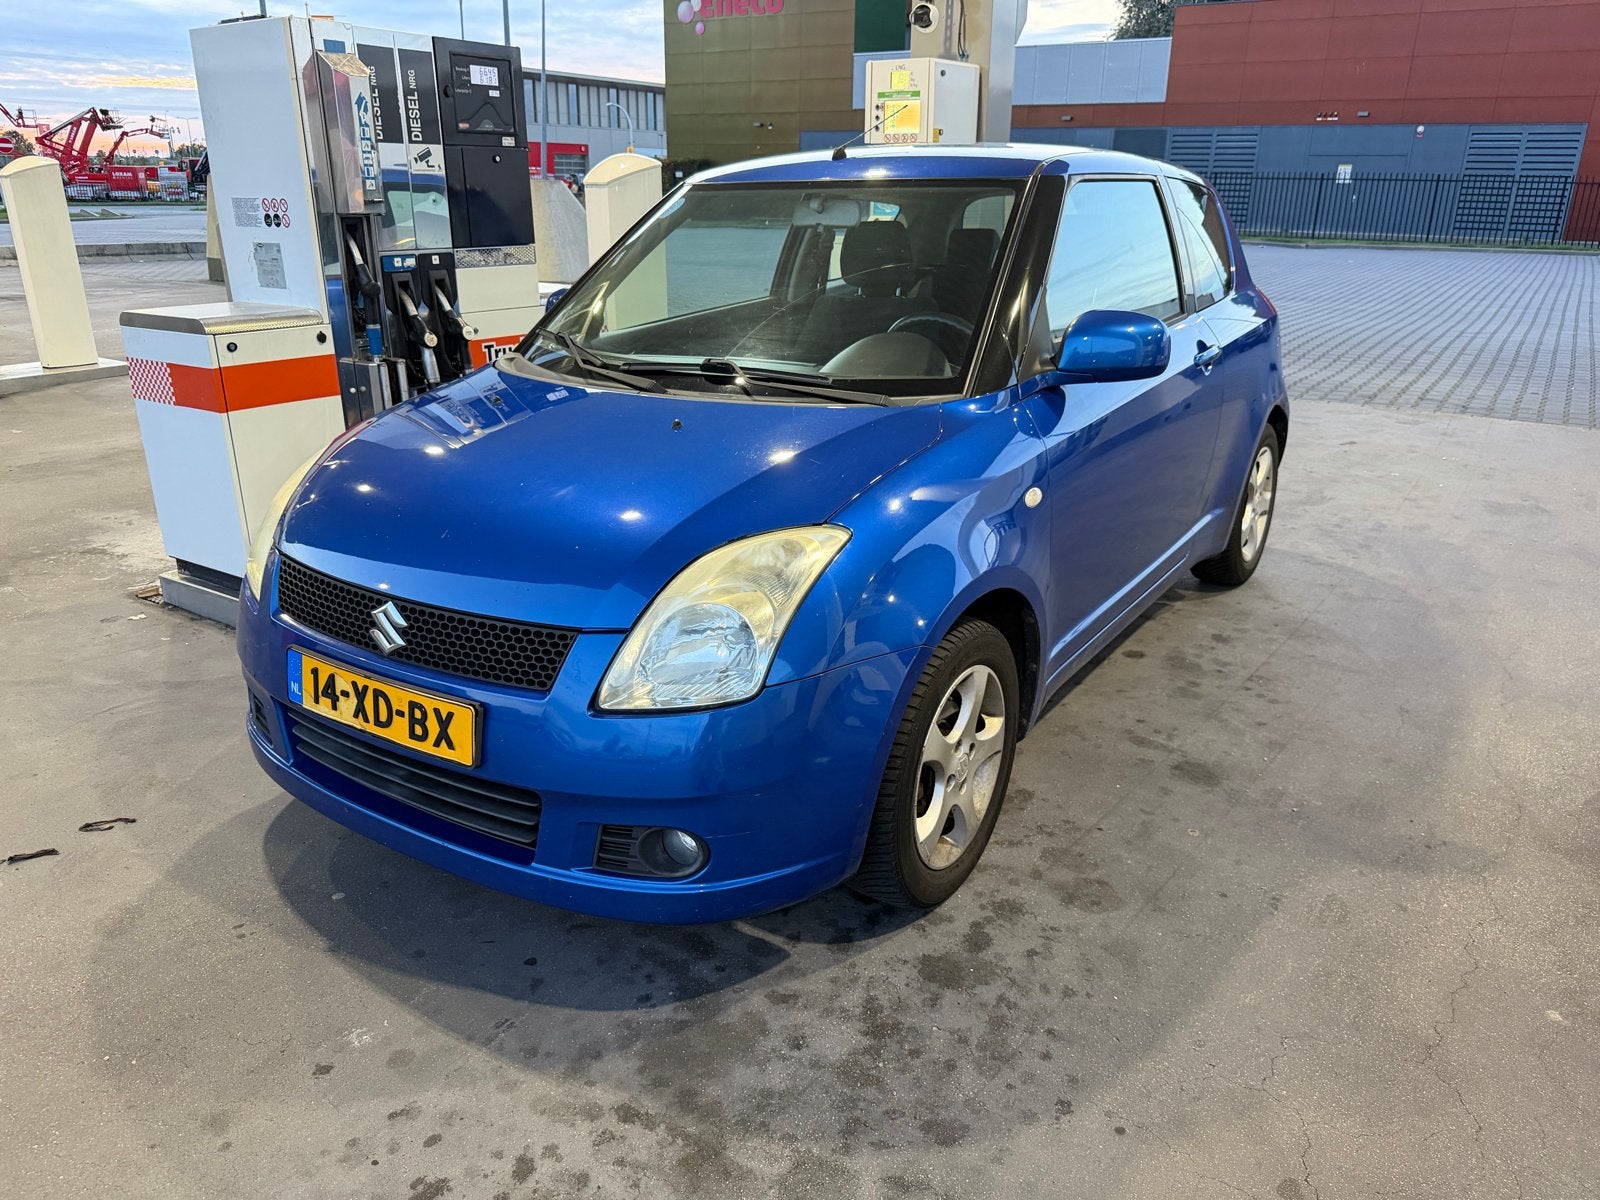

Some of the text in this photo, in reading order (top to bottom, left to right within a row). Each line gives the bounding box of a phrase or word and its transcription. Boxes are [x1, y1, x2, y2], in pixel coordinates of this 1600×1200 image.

[700, 0, 784, 18] eneco
[407, 69, 423, 141] DIESEL NRG
[291, 681, 301, 695] NL
[310, 666, 456, 751] 14-XD-BX
